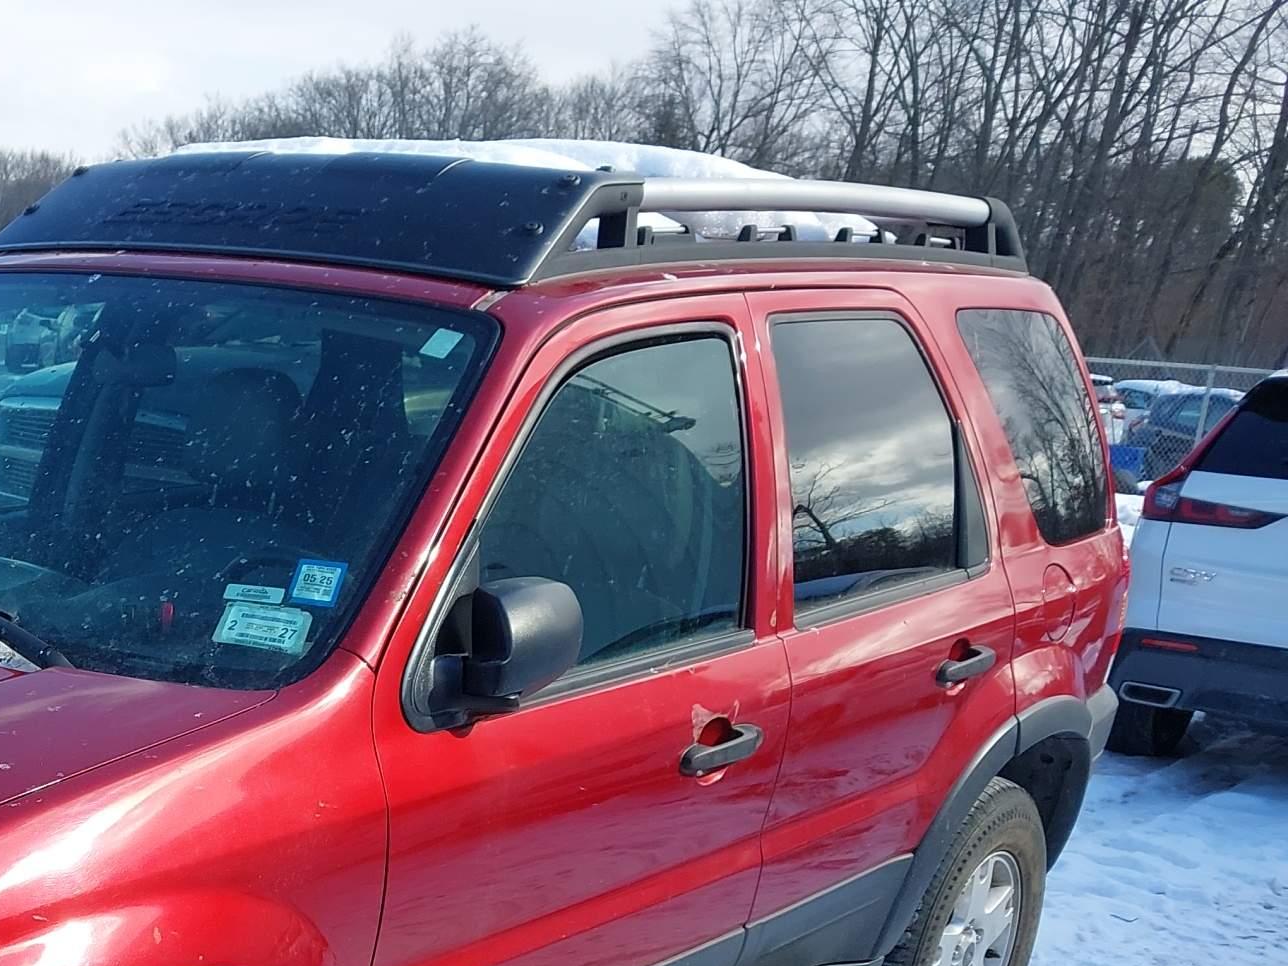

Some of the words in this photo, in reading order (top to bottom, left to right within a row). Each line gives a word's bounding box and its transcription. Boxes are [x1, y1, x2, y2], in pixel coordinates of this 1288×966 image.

[303, 573, 317, 583] 05
[319, 575, 334, 586] 25
[227, 619, 238, 631] 2
[278, 627, 298, 640] 27
